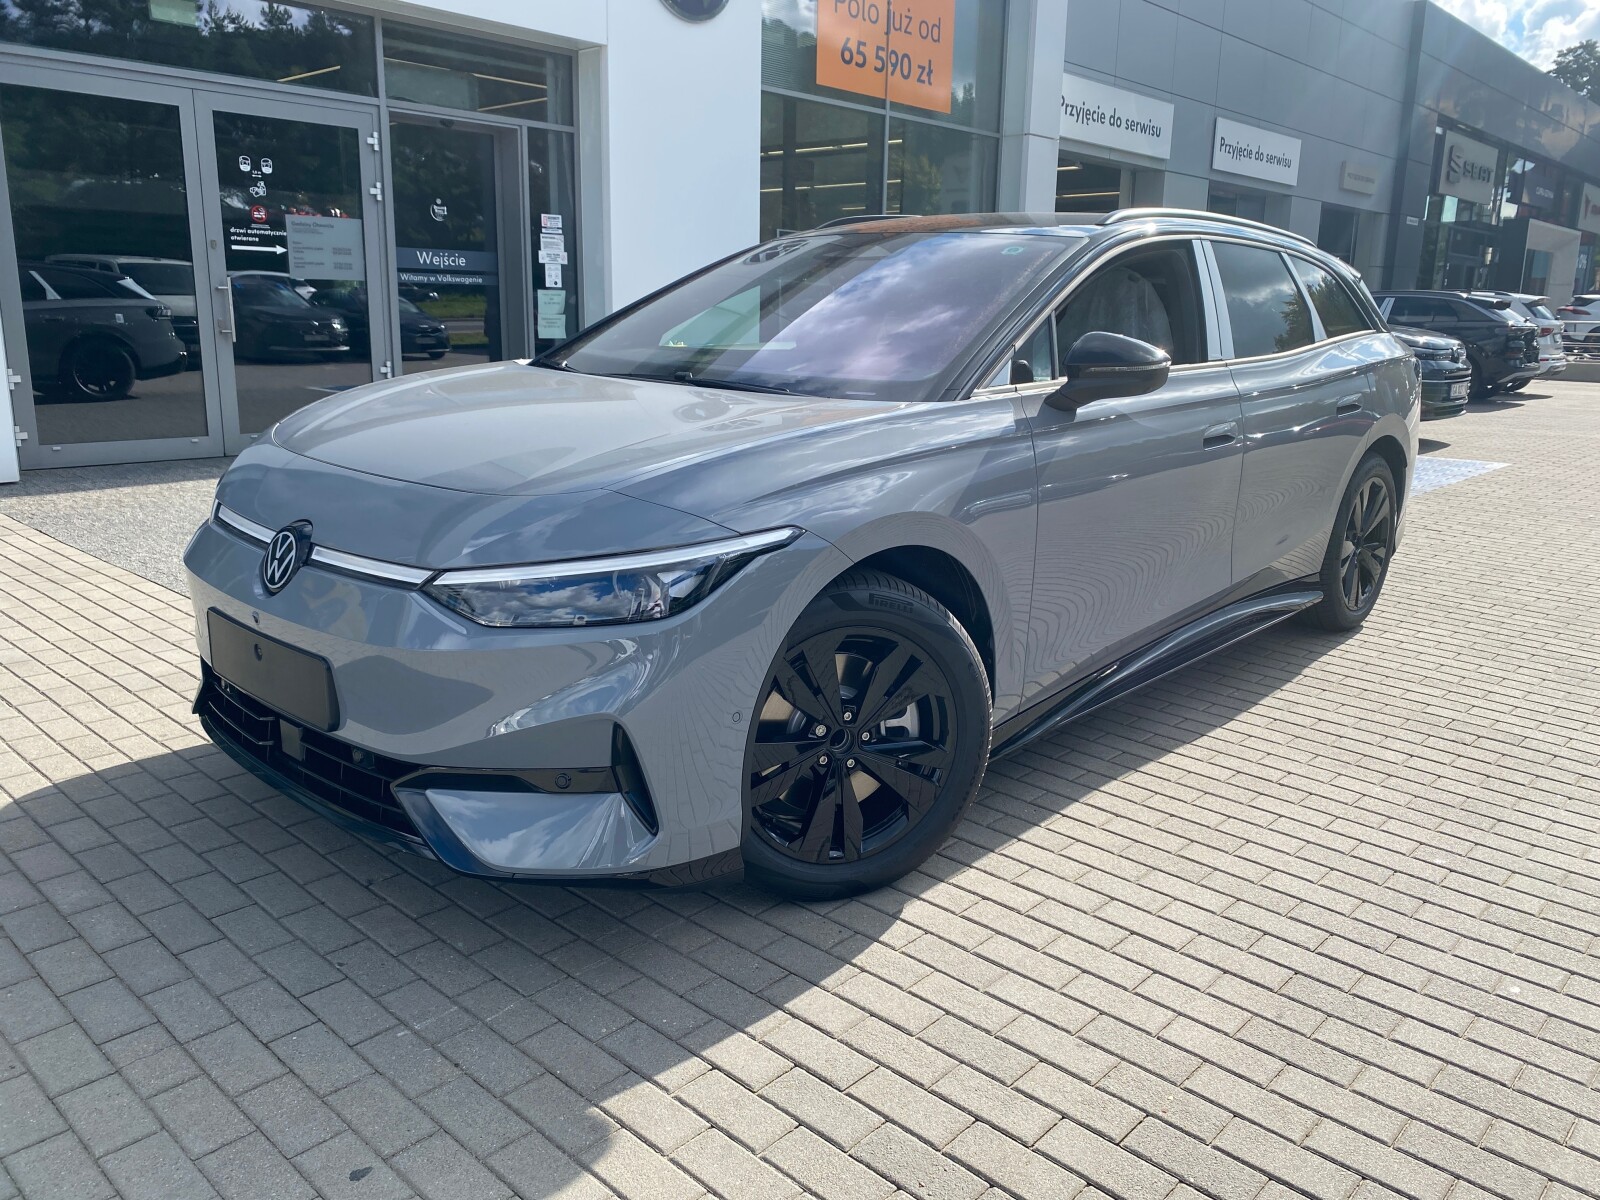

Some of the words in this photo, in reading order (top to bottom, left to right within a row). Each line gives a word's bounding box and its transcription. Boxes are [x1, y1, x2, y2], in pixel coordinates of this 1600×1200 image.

[884, 0, 912, 35] już
[919, 17, 941, 43] od
[841, 37, 867, 68] 65
[874, 45, 912, 80] 590
[917, 59, 933, 86] zł
[1109, 108, 1122, 128] do
[1125, 117, 1161, 138] serwisu
[1219, 136, 1253, 161] Przyjęcie
[1254, 145, 1264, 162] do
[1265, 152, 1292, 169] serwisu
[1462, 160, 1495, 184] SEAT
[230, 226, 247, 234] drzwi
[247, 228, 287, 236] automatycznie
[416, 250, 466, 269] Wejście
[400, 273, 428, 283] Witamy
[437, 274, 483, 284] Volkswagenie
[868, 592, 914, 614] PIRELLI
